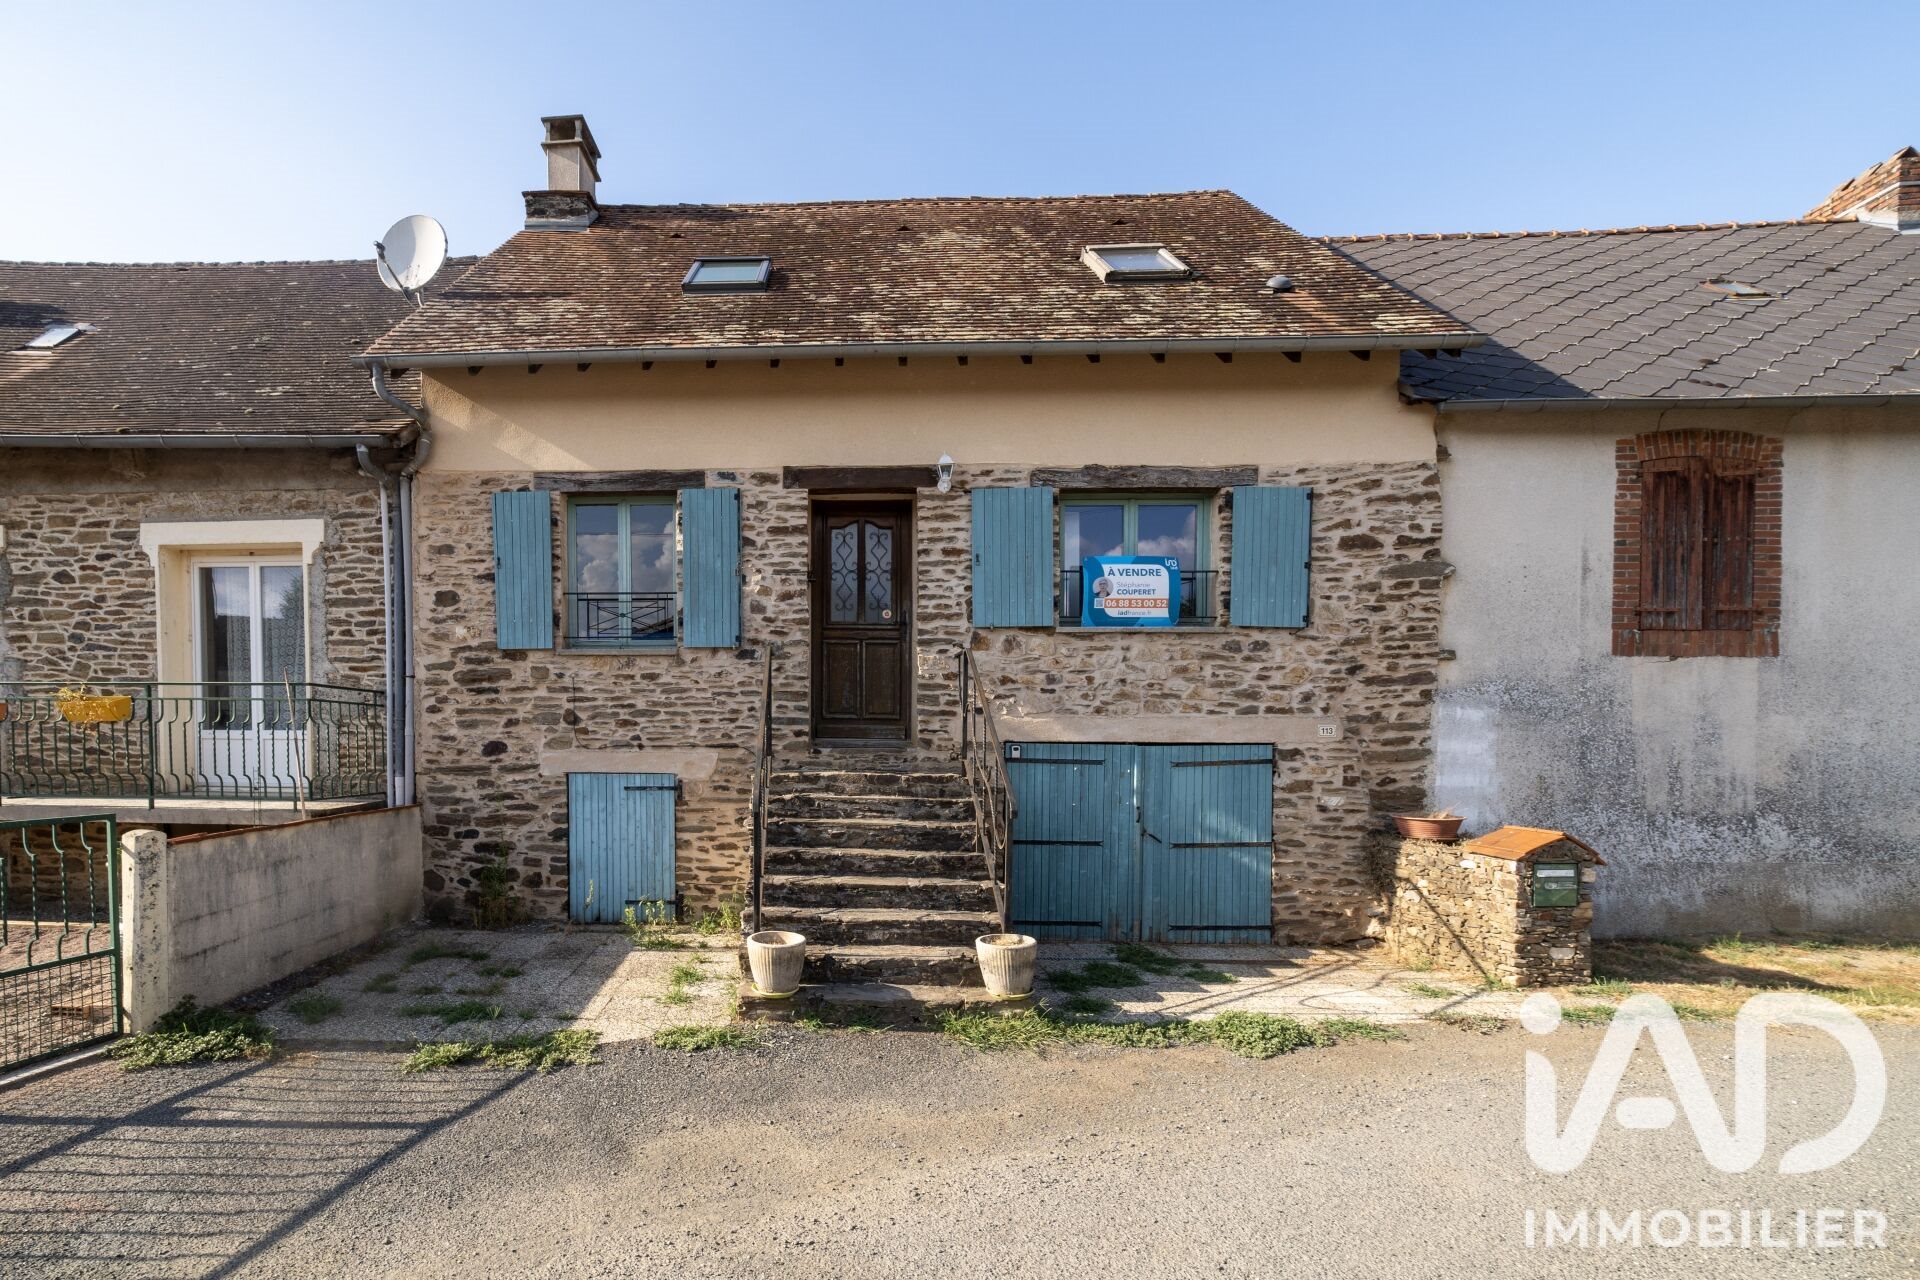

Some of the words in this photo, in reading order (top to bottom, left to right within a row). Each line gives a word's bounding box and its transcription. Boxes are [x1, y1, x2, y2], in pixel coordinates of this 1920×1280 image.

[1108, 566, 1115, 577] À
[1118, 568, 1162, 576] VENDRE
[1106, 599, 1117, 607] 06
[1118, 599, 1129, 607] 88
[1131, 599, 1142, 607] 53
[1143, 599, 1154, 607] 00
[1156, 599, 1167, 607] 52
